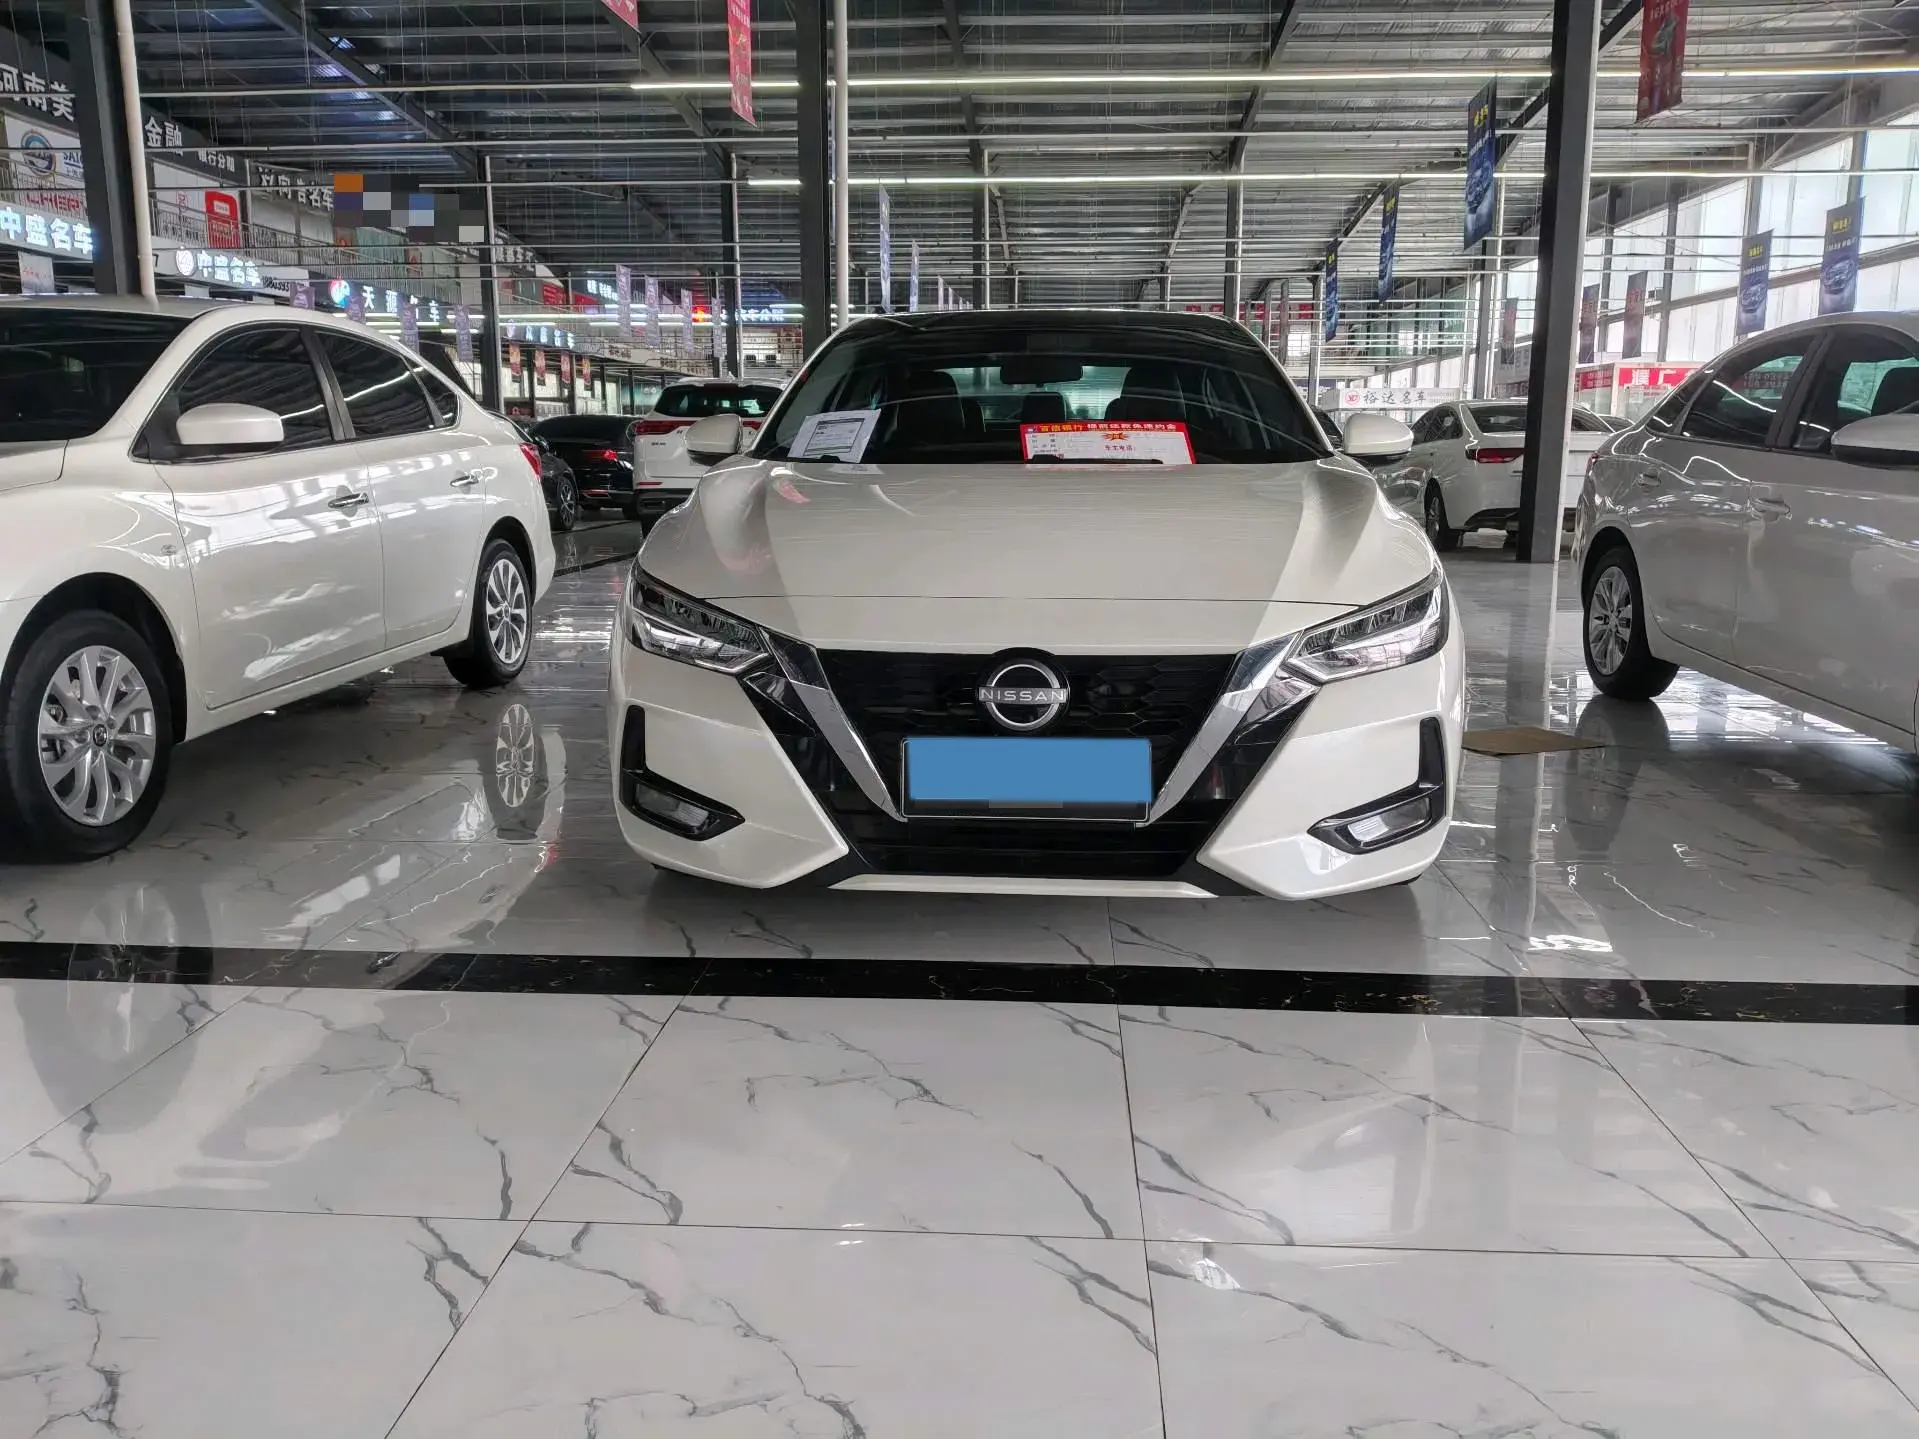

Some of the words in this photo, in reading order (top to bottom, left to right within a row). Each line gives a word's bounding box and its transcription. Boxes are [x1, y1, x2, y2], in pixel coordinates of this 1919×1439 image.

[145, 116, 183, 156] 金融
[0, 206, 93, 255] 中盛名车
[981, 688, 1064, 702] NISSAN
